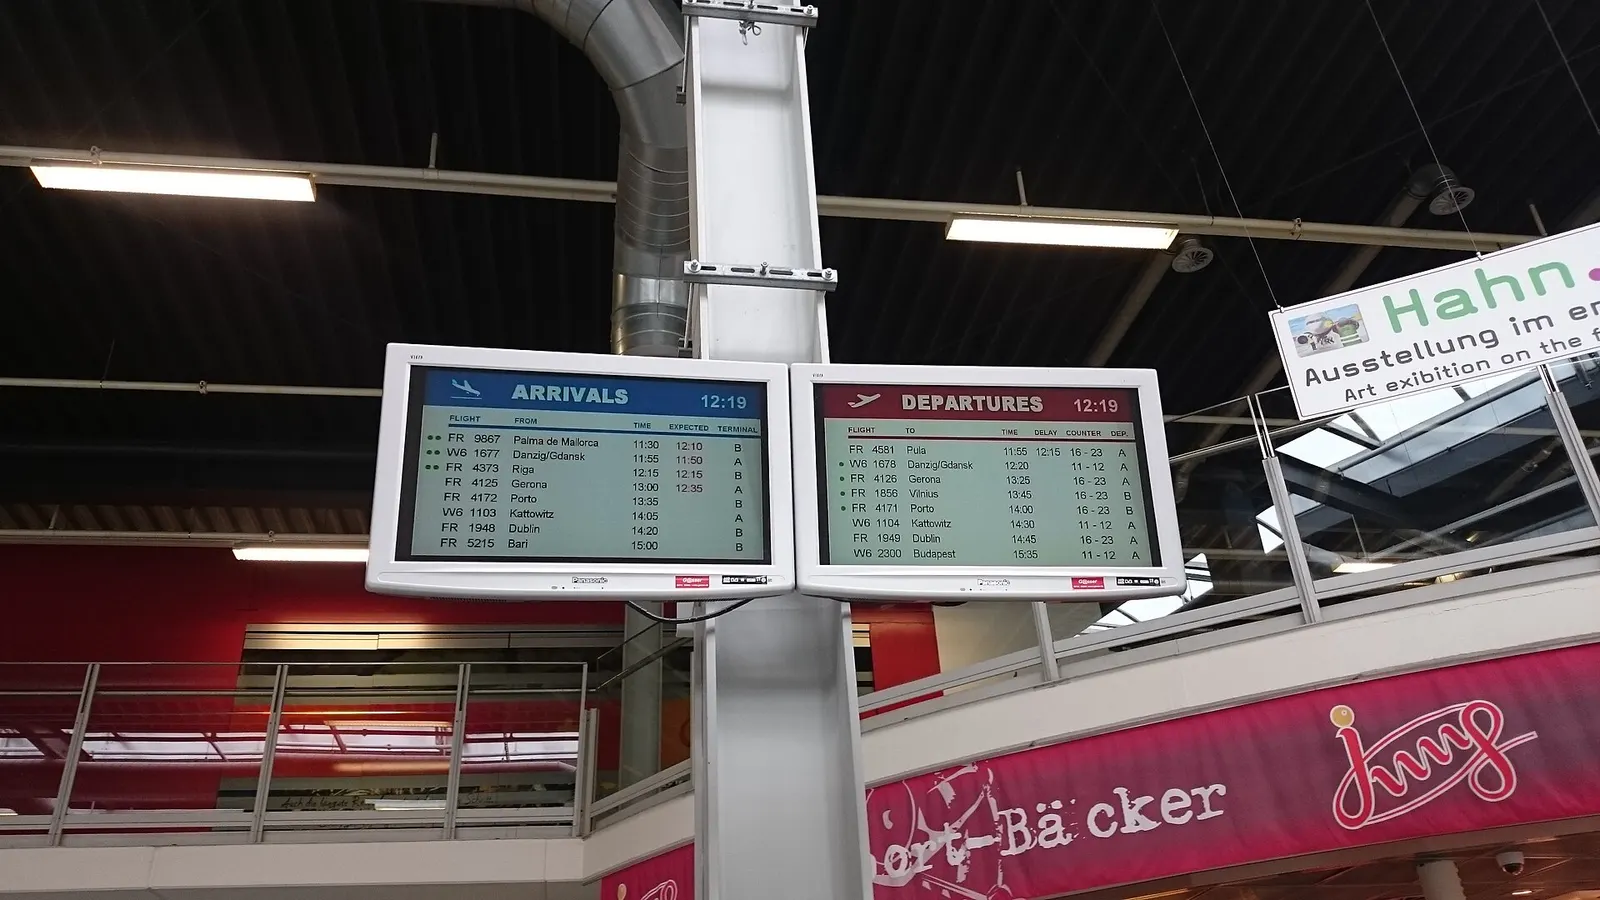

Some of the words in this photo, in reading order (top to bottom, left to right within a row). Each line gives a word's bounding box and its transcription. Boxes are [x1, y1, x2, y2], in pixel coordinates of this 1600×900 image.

[1305, 326, 1499, 386] Ausstellung
[1508, 316, 1554, 336] im
[1344, 383, 1377, 402] Art
[1386, 360, 1491, 393] exibition
[1501, 347, 1531, 365] on
[1539, 338, 1582, 355] the
[512, 385, 628, 404] ARRIVALS
[702, 395, 746, 409] 12:19
[902, 395, 1043, 412] DEPARTURES
[1074, 399, 1117, 412] 12:19
[669, 423, 709, 431] EXPECTED
[718, 425, 758, 433] TERMINAL
[448, 433, 464, 442] FR
[475, 434, 500, 443] 9867
[513, 436, 543, 445] Palma
[547, 437, 558, 445] de
[562, 438, 598, 447] Mallorca
[634, 440, 659, 449] 11:30
[677, 442, 702, 451] 12:10
[735, 444, 741, 452] B
[447, 448, 467, 457] W6
[475, 448, 500, 458] 1677
[512, 450, 585, 461] Danzig/Gdansk
[634, 455, 659, 463] 11:55
[677, 456, 702, 464] 11:50
[733, 458, 742, 466] A
[850, 444, 863, 453] FR
[872, 446, 893, 454] 4581
[906, 446, 927, 454] Pula
[1004, 447, 1027, 455] 11:55
[1037, 448, 1060, 457] 12:15
[1070, 448, 1081, 456] 16
[1091, 449, 1102, 457] 23
[1118, 449, 1126, 457] A
[446, 463, 462, 471] FR
[473, 464, 498, 472] 4373
[513, 465, 534, 475] Riga
[634, 469, 658, 477] 12:15
[677, 470, 703, 478] 12:15
[849, 460, 868, 468] W6
[873, 460, 896, 468] 1678
[907, 460, 973, 471] Danzig/Gdansk
[1005, 462, 1028, 470] 12:20
[1093, 463, 1104, 472] 12
[1120, 462, 1128, 471] A
[445, 478, 461, 486] FR
[472, 479, 498, 487] 4125
[512, 479, 548, 488] Gerona
[633, 483, 658, 492] 13:00
[676, 484, 703, 492] 12:35
[850, 473, 864, 482] FR
[874, 475, 898, 483] 4126
[908, 474, 940, 483] Gerona
[1007, 476, 1030, 484] 13:25
[1074, 477, 1084, 486] 16
[1094, 476, 1106, 485] 23
[1122, 477, 1130, 485] A
[444, 493, 460, 501] FR
[471, 493, 497, 502] 4172
[510, 494, 537, 503] Porto
[633, 497, 658, 506] 13:35
[736, 500, 742, 508] B
[852, 489, 865, 497] FR
[875, 488, 899, 497] 1856
[909, 489, 938, 498] Vilnius
[1008, 491, 1031, 499] 13:45
[1075, 491, 1086, 499] 16
[1096, 492, 1108, 500] 23
[1123, 492, 1131, 501] B
[443, 508, 463, 516] W6
[471, 508, 496, 518] 1103
[510, 509, 554, 518] Kattowitz
[633, 512, 658, 520] 14:05
[735, 514, 743, 522] A
[852, 504, 866, 512] FR
[876, 504, 898, 512] 4171
[910, 503, 934, 512] Porto
[1009, 505, 1034, 513] 14:00
[1077, 505, 1088, 514] 16
[1098, 506, 1109, 514] 23
[1126, 507, 1133, 515] B
[442, 523, 459, 532] FR
[469, 523, 495, 532] 1948
[509, 524, 539, 534] Dublin
[632, 527, 659, 536] 14:20
[736, 528, 743, 537] B
[852, 519, 871, 527] W6
[877, 519, 900, 527] 1104
[911, 519, 951, 528] Kattowitz
[1011, 520, 1034, 528] 14:30
[1079, 521, 1089, 529] 11
[1100, 521, 1112, 529] 12
[441, 537, 457, 547] FR
[467, 539, 494, 548] 5215
[507, 538, 528, 548] Bari
[632, 540, 658, 550] 15:00
[736, 542, 743, 551] B
[854, 534, 868, 542] FR
[878, 534, 900, 542] 1949
[912, 534, 940, 543] Dublin
[1012, 535, 1036, 543] 14:45
[1081, 536, 1092, 544] 16
[1101, 536, 1113, 544] 23
[1129, 536, 1138, 544] A
[853, 549, 872, 557] W6
[878, 549, 901, 558] 2300
[913, 549, 955, 560] Budapest
[1014, 549, 1038, 558] 15:35
[1082, 551, 1093, 559] 11
[1104, 550, 1116, 559] 12
[1131, 551, 1140, 559] A
[572, 576, 608, 585] Panasonic
